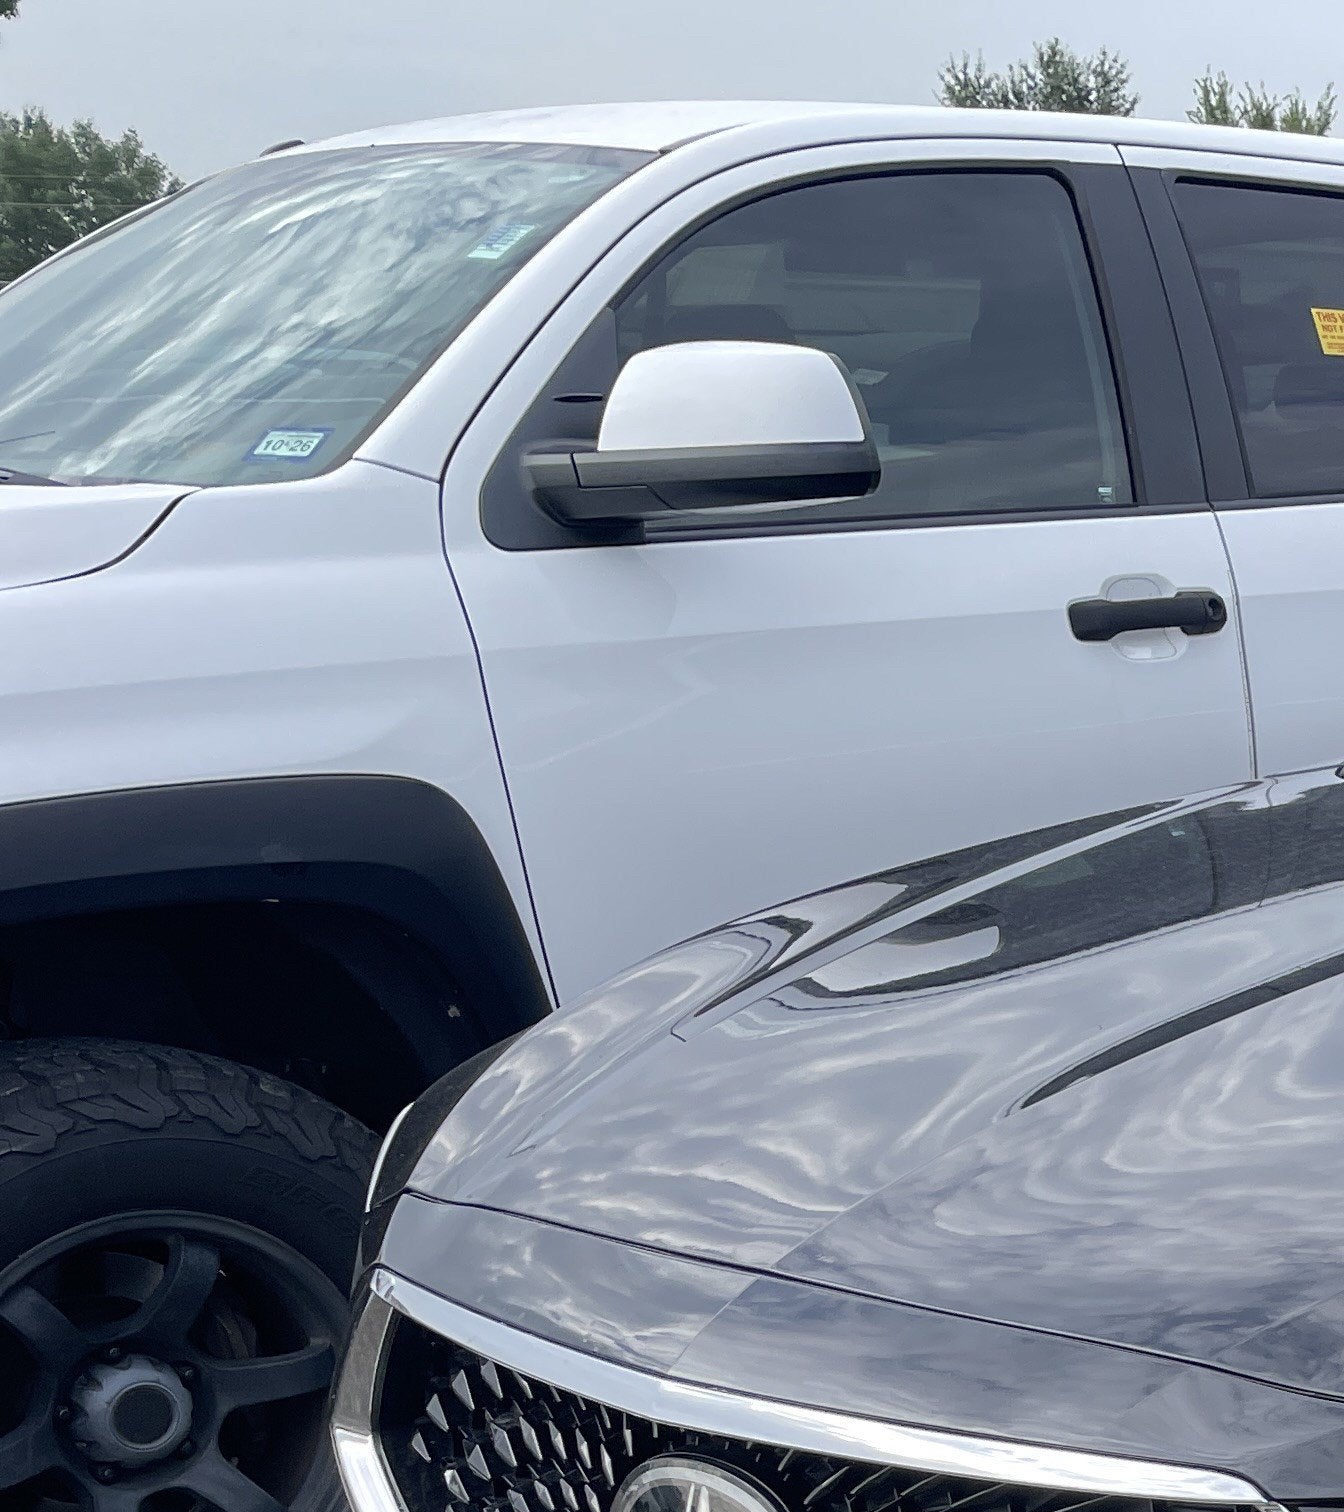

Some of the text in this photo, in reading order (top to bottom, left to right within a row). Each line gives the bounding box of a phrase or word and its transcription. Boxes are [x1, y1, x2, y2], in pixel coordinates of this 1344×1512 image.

[1316, 311, 1338, 324] THIS
[1321, 324, 1338, 333] NOT
[263, 439, 285, 451] 10
